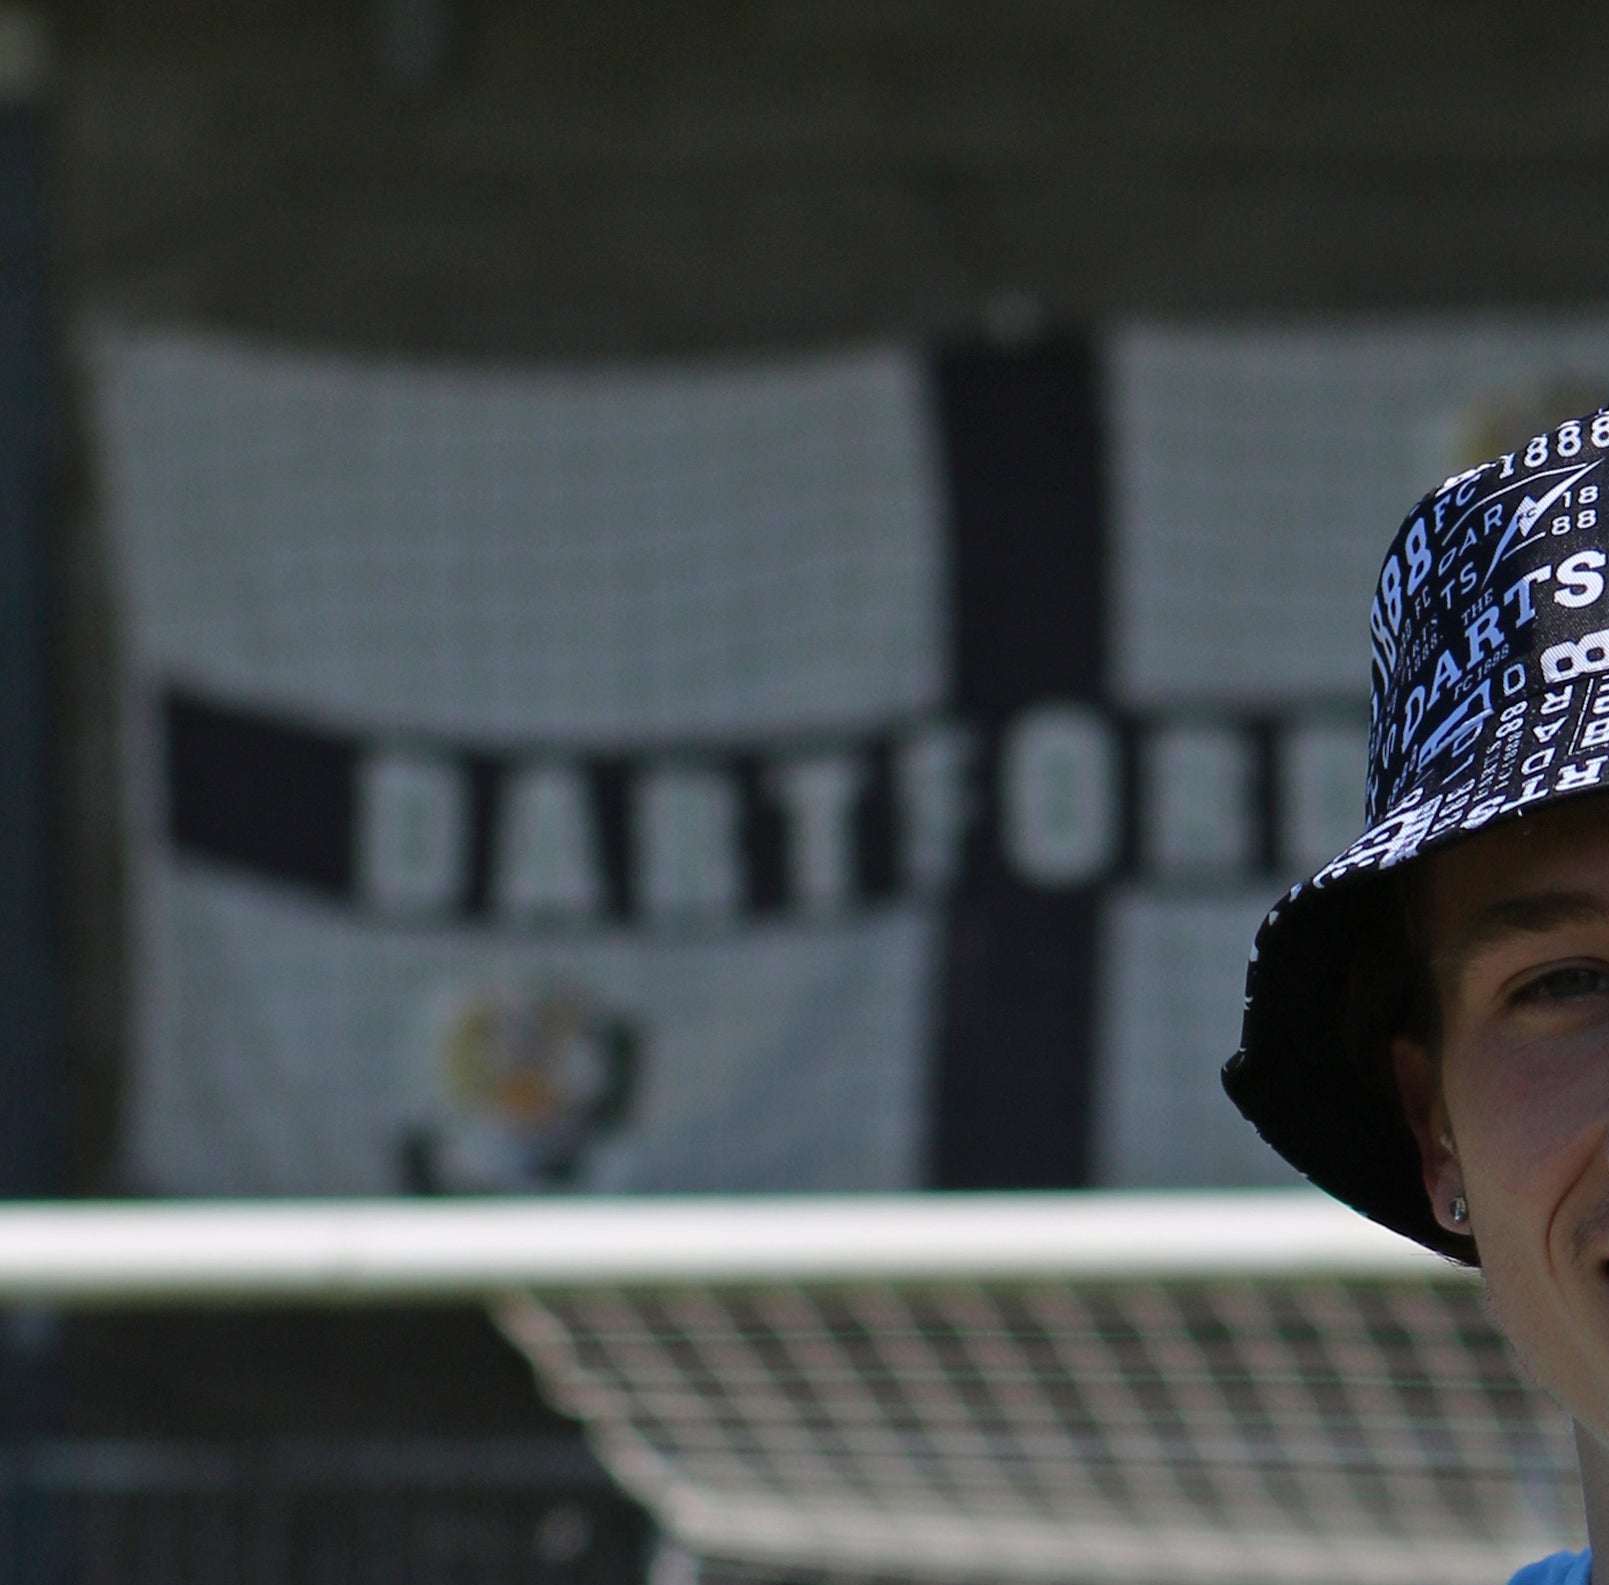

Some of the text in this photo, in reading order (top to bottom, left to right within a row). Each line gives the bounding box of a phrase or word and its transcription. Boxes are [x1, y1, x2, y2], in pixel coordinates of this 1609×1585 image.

[1562, 485, 1598, 508] 18
[1551, 509, 1597, 536] 88
[1460, 588, 1494, 627] THE
[1402, 550, 1606, 752] DARTS
